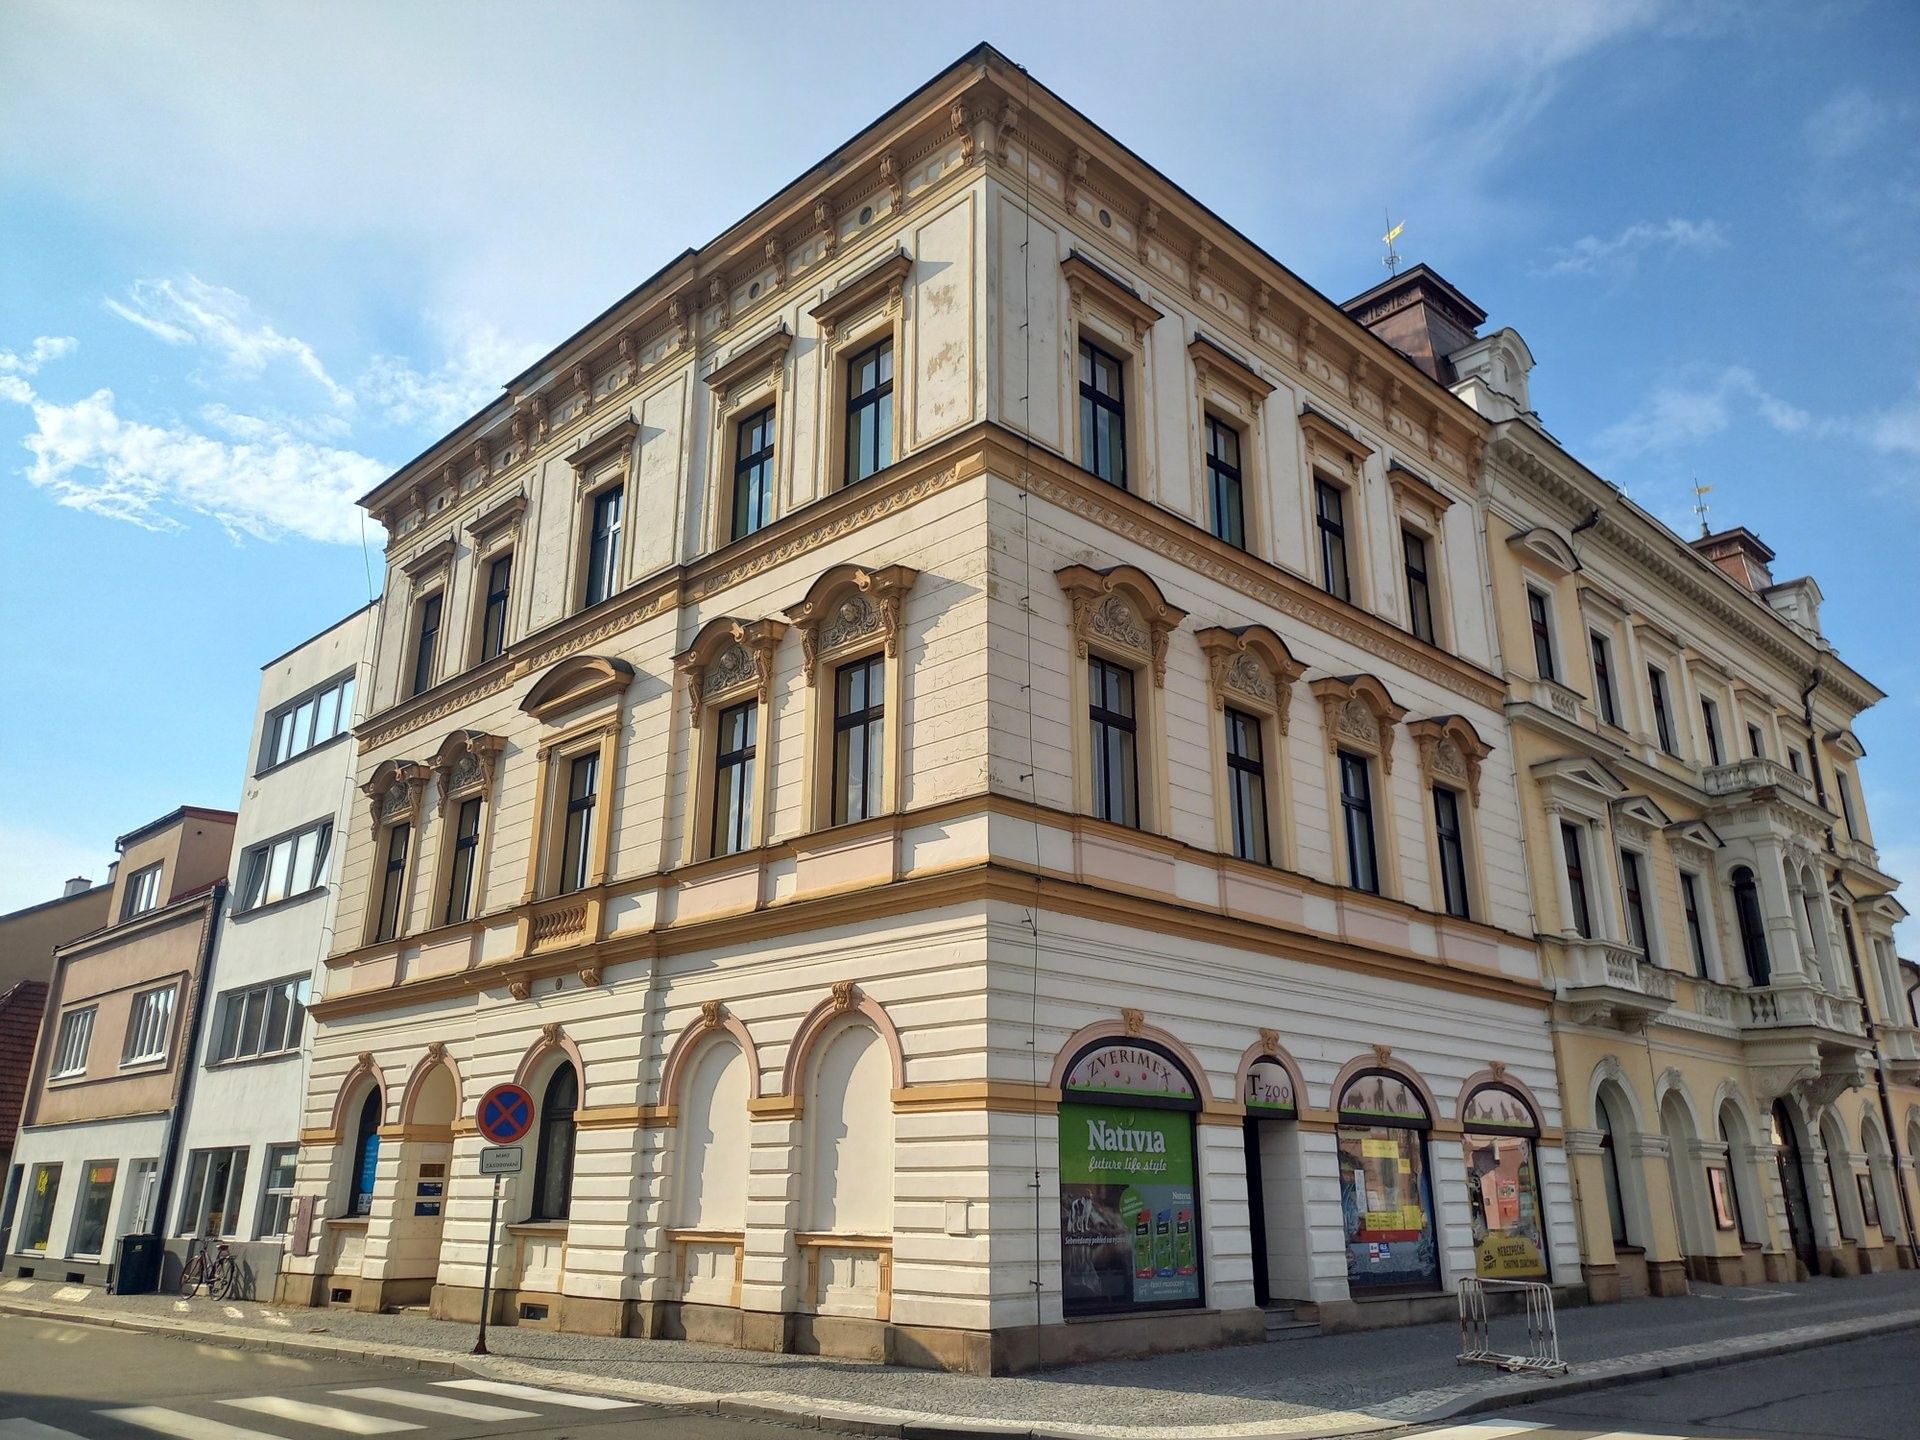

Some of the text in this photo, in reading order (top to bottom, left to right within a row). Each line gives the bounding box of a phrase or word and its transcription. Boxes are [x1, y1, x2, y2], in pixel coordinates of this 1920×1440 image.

[1087, 1050, 1171, 1084] ZVERIMEX
[1086, 1119, 1166, 1153] Nativia
[1088, 1156, 1167, 1175] future life style
